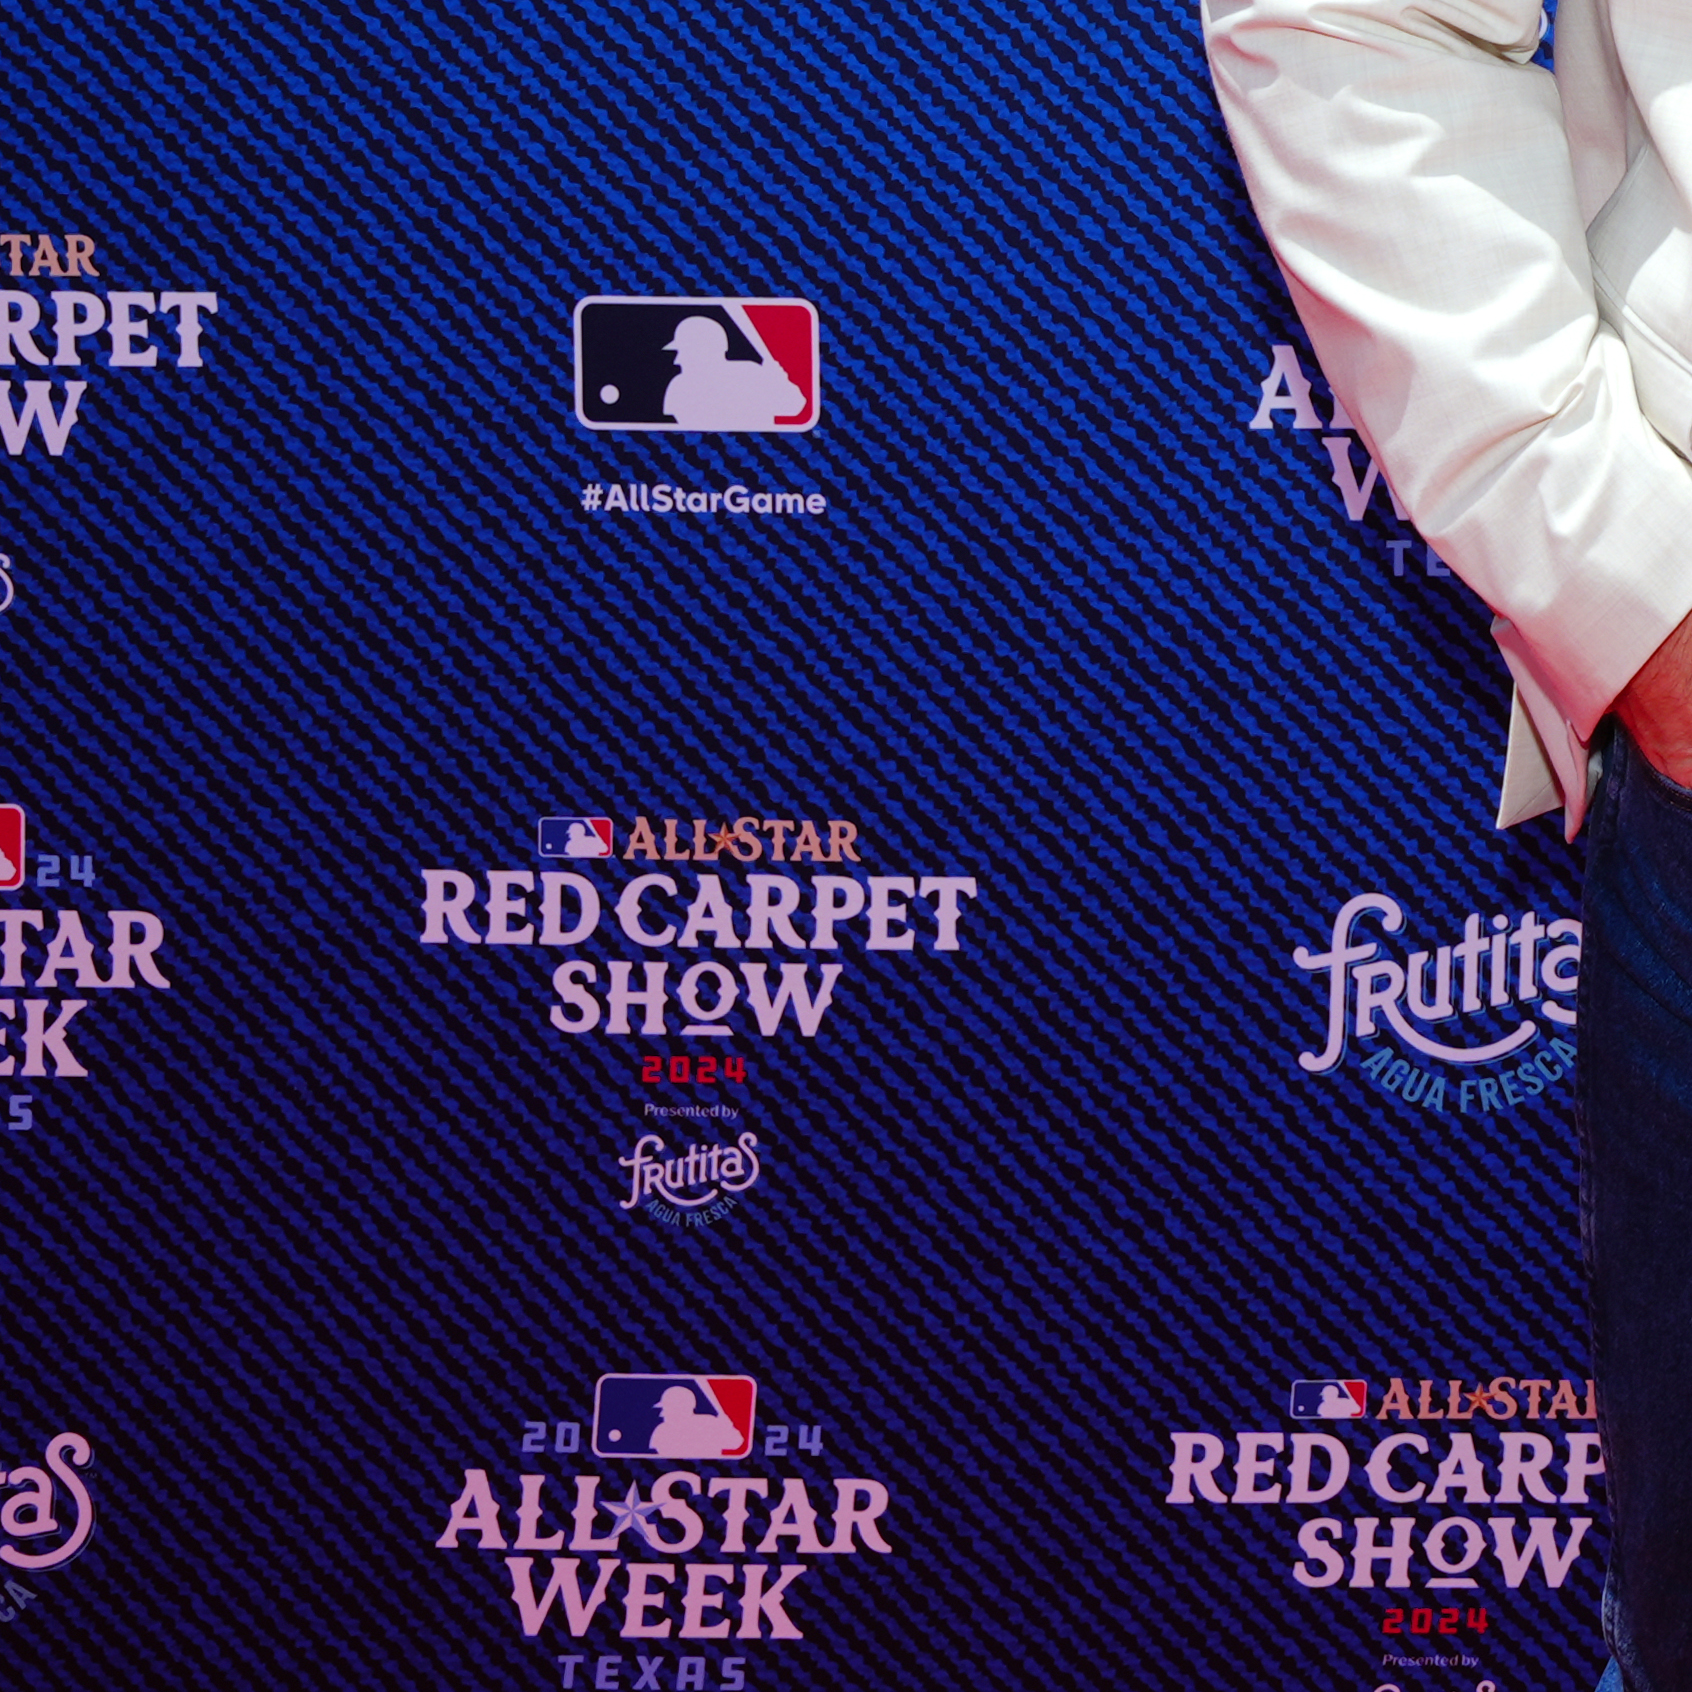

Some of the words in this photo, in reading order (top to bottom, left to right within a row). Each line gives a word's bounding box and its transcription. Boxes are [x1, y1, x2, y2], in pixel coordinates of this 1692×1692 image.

[582, 484, 826, 514] #AllStarGame
[420, 869, 600, 945] RED
[615, 874, 977, 950] CARPET
[550, 961, 842, 1036] SHOW
[1293, 892, 1582, 1074] Frutita
[642, 1056, 747, 1084] 2024
[1361, 1046, 1446, 1111] AGUA
[1460, 1036, 1578, 1113] FRESCA
[644, 1103, 719, 1118] Presented
[722, 1104, 739, 1119] by
[647, 1199, 681, 1226] AGUA
[685, 1195, 738, 1227] FRESCA
[522, 1421, 580, 1453] 20
[765, 1425, 823, 1456] 24
[1166, 1432, 1349, 1503] RED
[1293, 1517, 1592, 1588] SHOW
[505, 1557, 807, 1639] WEEK
[1382, 1608, 1489, 1634] 2024
[558, 1655, 745, 1690] TEXAS
[1382, 1654, 1458, 1667] Presented
[1461, 1654, 1480, 1668] by
